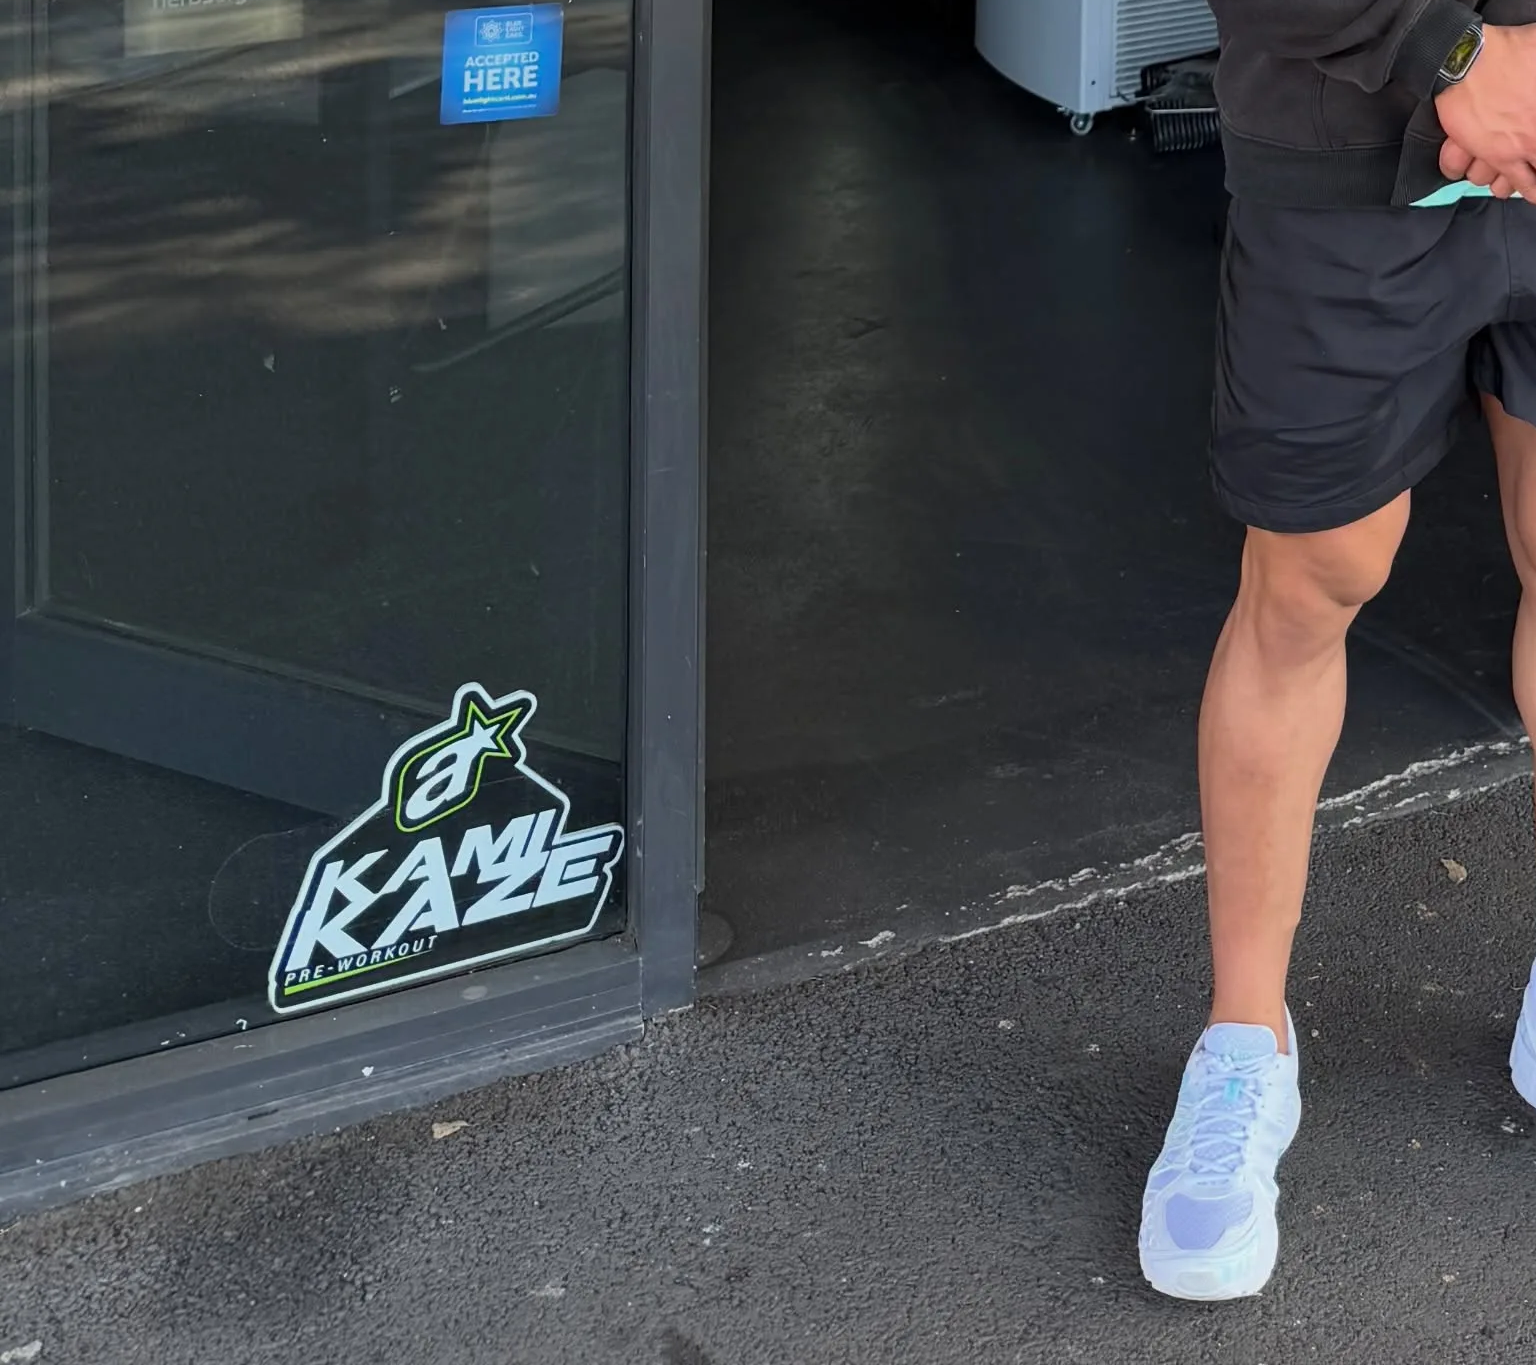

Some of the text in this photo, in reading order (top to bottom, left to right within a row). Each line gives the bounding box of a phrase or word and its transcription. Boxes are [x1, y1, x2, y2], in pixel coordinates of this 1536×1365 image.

[464, 51, 540, 68] ACCEPTED
[463, 65, 539, 93] HERE
[283, 934, 439, 987] PRE-WORKOUT
